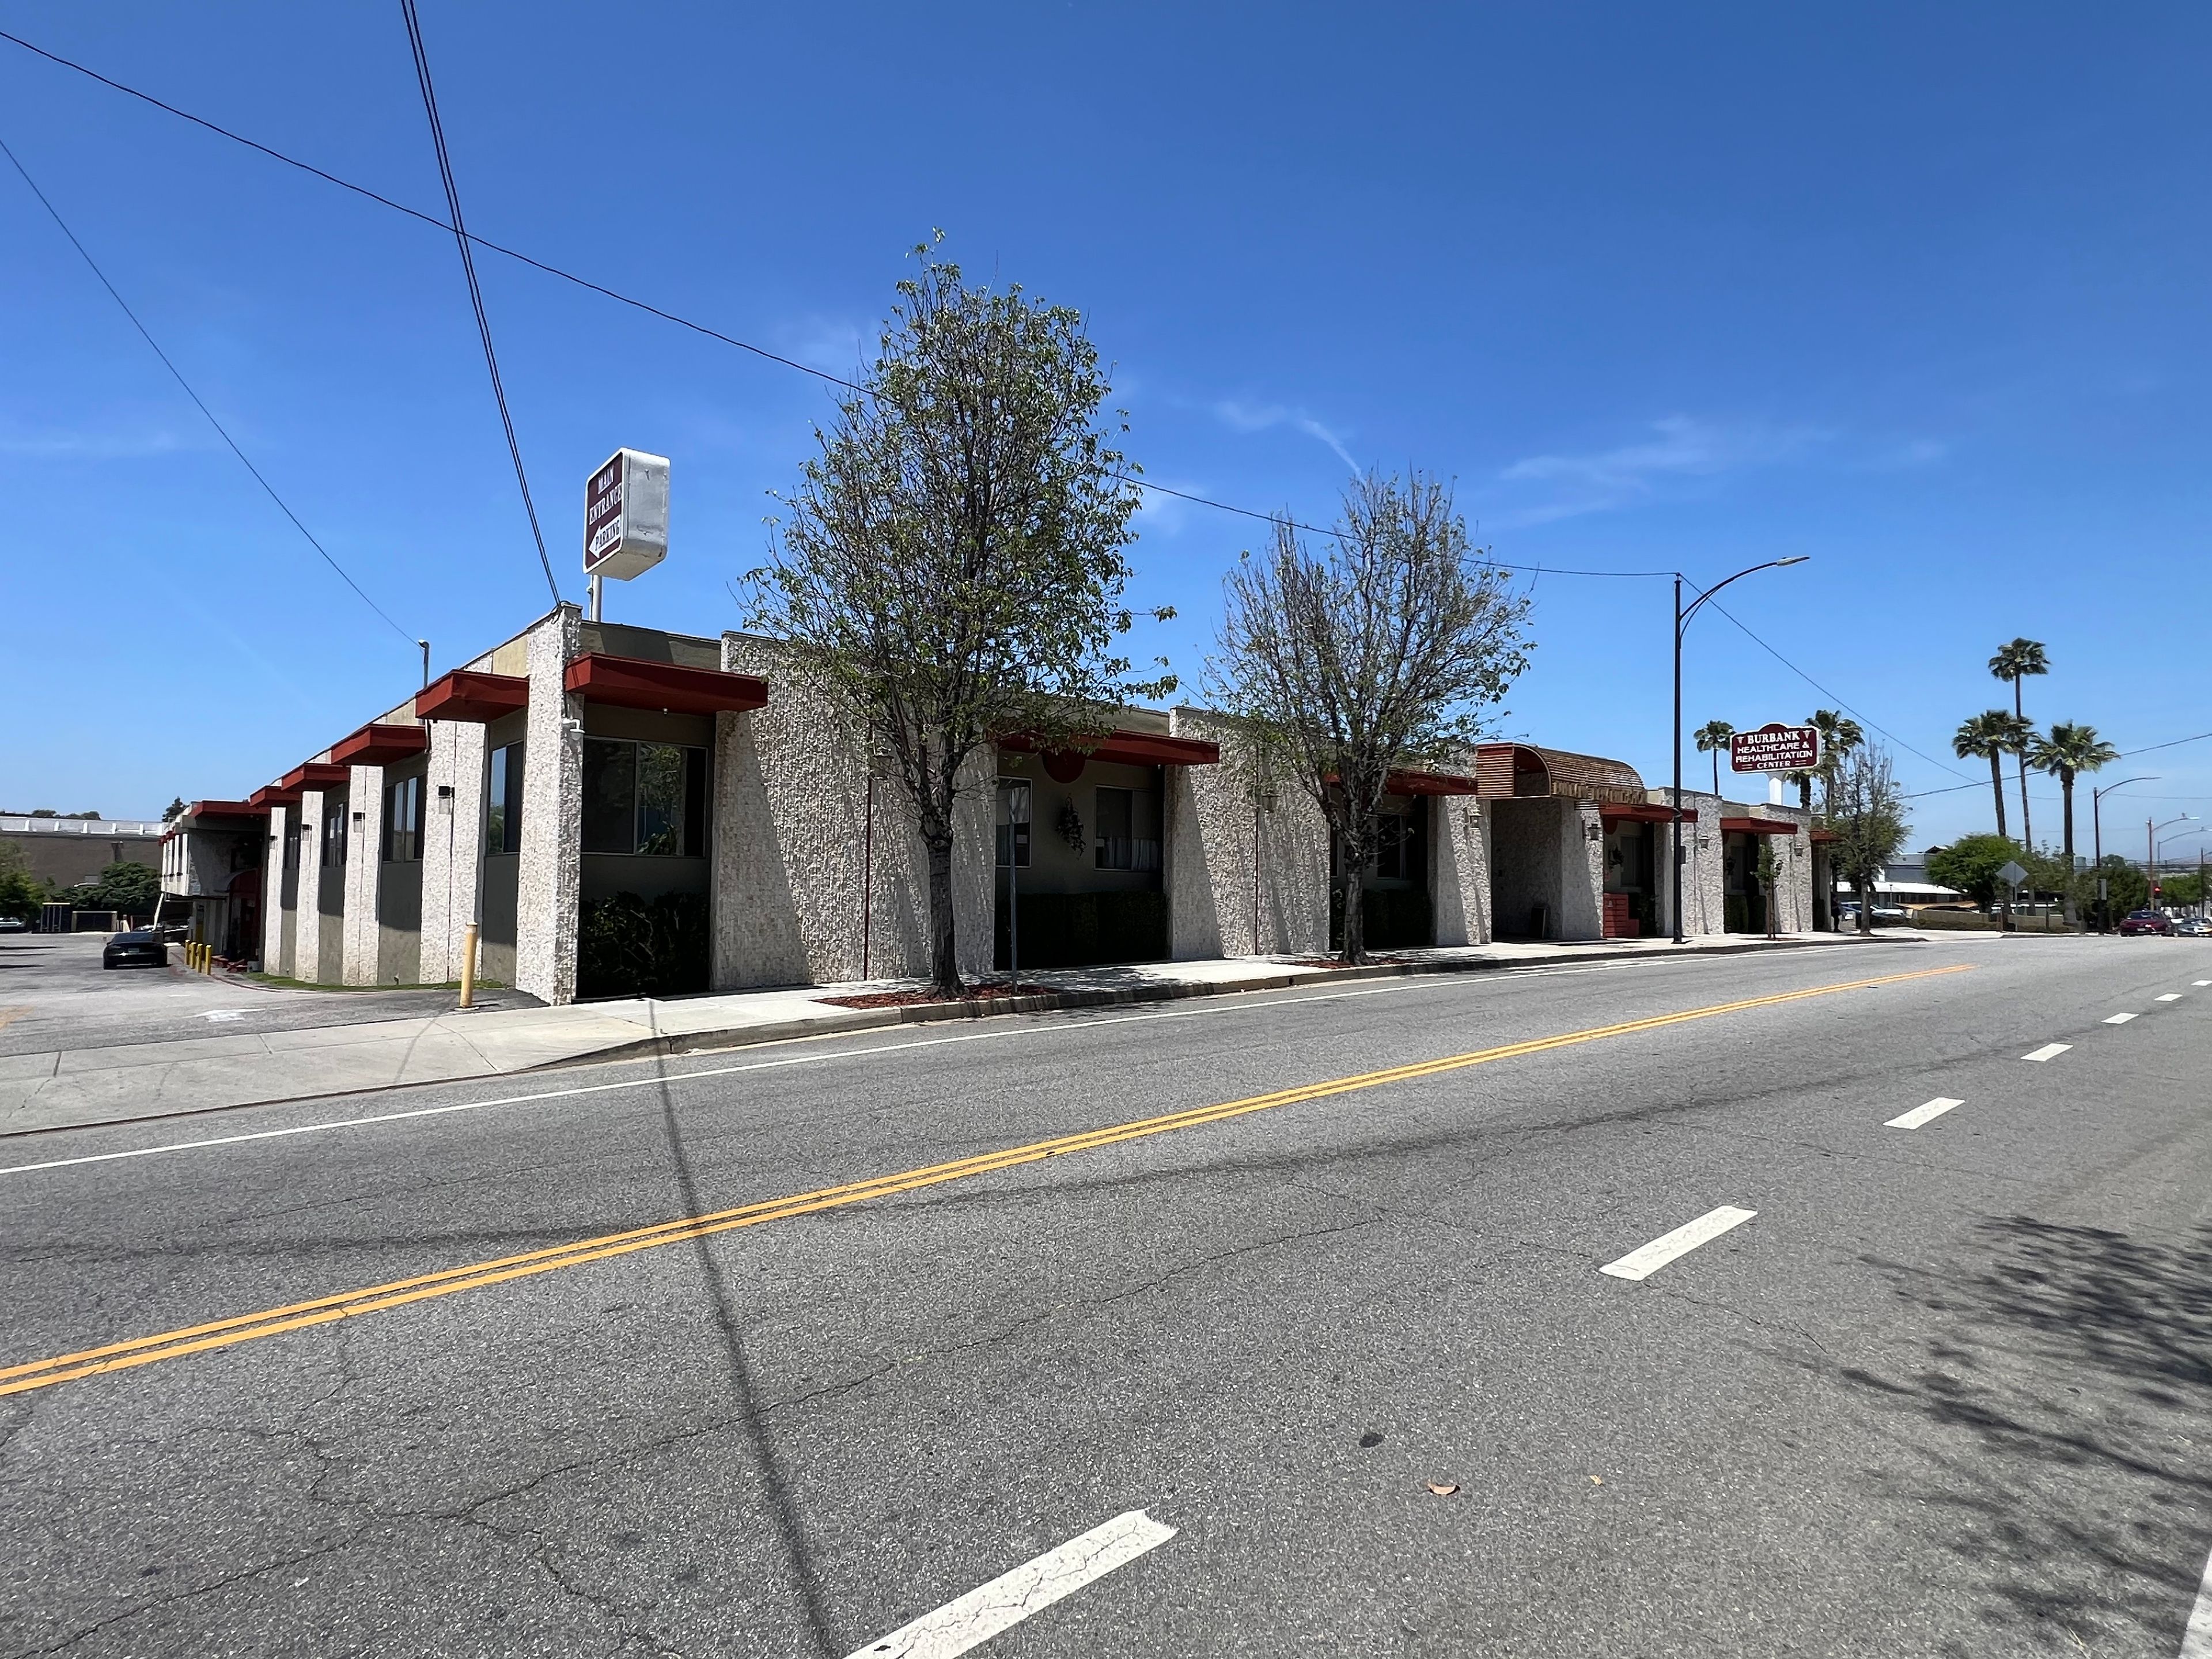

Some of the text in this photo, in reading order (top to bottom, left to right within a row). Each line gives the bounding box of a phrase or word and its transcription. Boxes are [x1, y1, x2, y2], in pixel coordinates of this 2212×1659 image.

[598, 465, 614, 495] MAIN
[589, 482, 622, 525] ENTRANCE
[595, 519, 620, 551] PARKING
[1747, 731, 1800, 744] BURBANK
[1737, 742, 1800, 754] HEALTHCARE
[1736, 750, 1813, 763] REHABILITATION
[1757, 760, 1791, 769] CENTER
